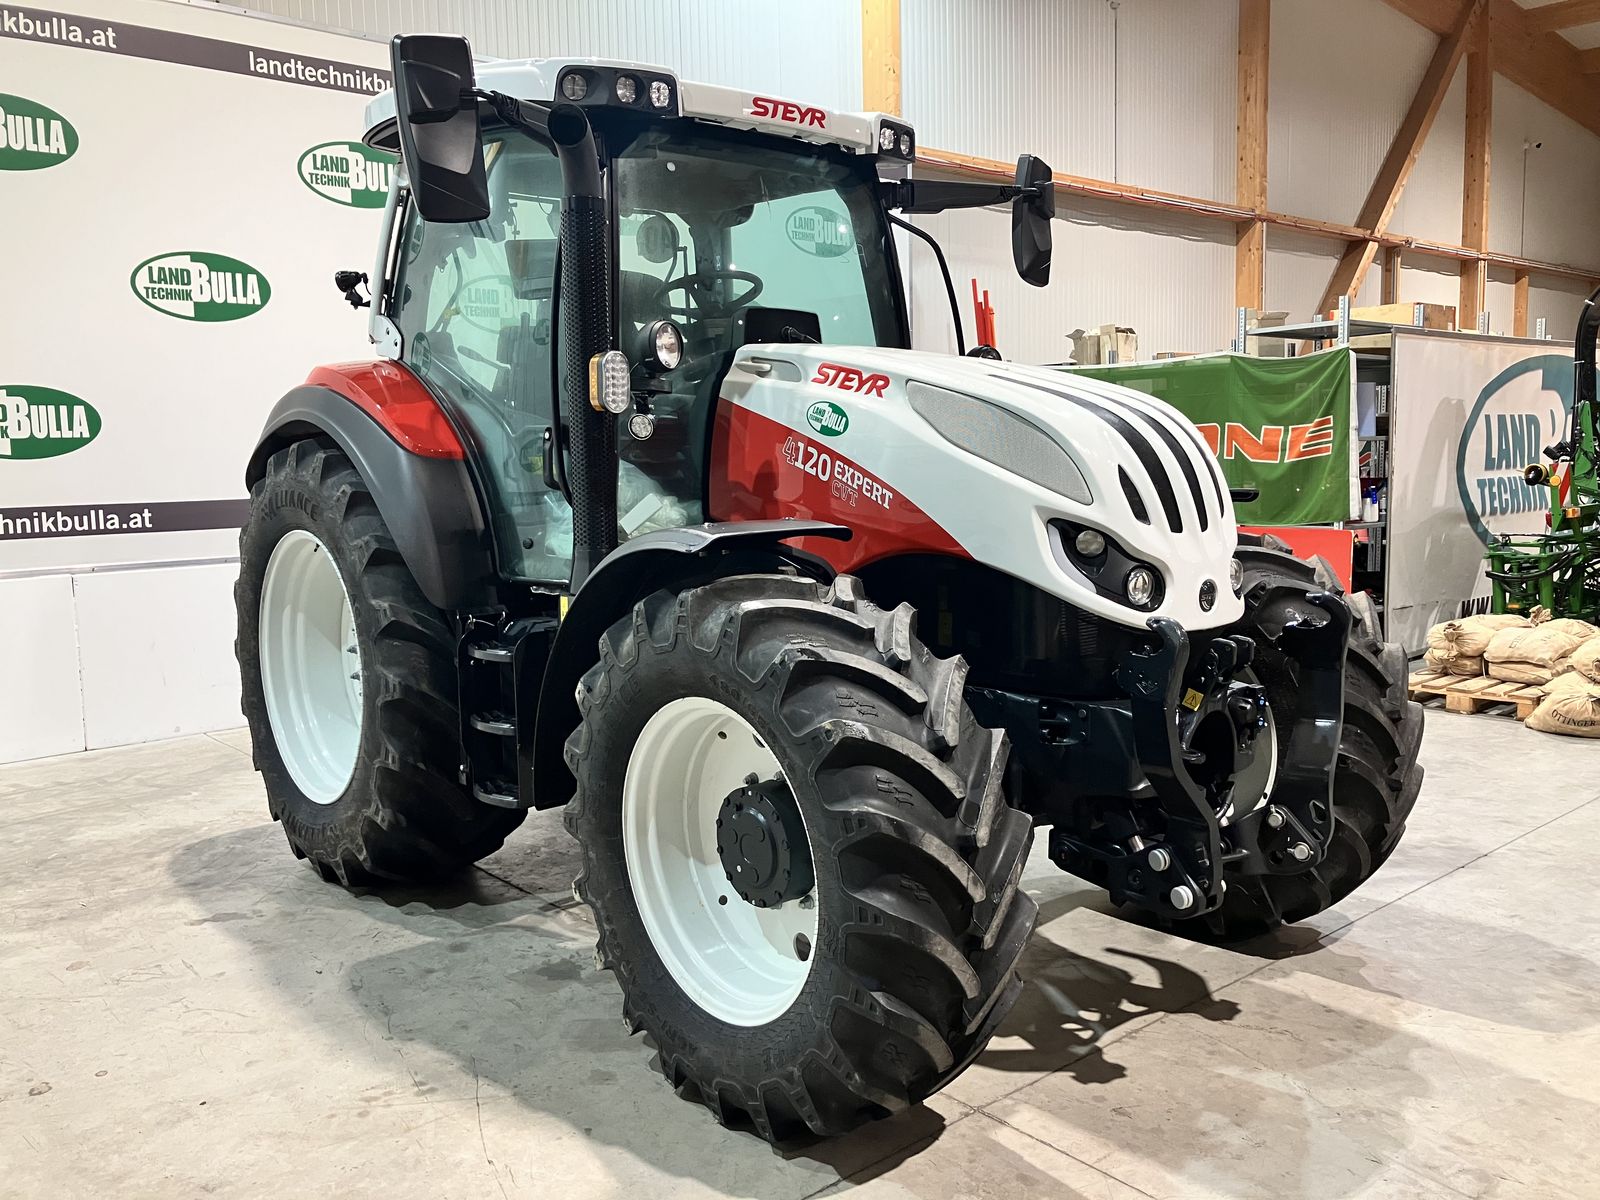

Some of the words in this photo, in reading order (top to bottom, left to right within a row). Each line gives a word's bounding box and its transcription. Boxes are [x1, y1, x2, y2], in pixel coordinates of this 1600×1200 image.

[0, 10, 117, 48] kbulla.at
[750, 97, 826, 128] STEYR
[312, 153, 350, 174] LAND
[309, 172, 351, 188] TECHNIK
[793, 215, 815, 231] LAND
[147, 265, 192, 286] LAND
[191, 261, 262, 305] BULLA
[143, 286, 193, 302] TECHNIK
[811, 362, 890, 398] STEYR
[7, 395, 90, 439] BULLA
[822, 406, 847, 433] BULLA
[1484, 414, 1541, 471] LAND
[782, 436, 832, 482] 4120
[834, 460, 893, 509] EXPERT
[831, 480, 859, 507] CVT
[0, 508, 153, 535] hnikbulla.at
